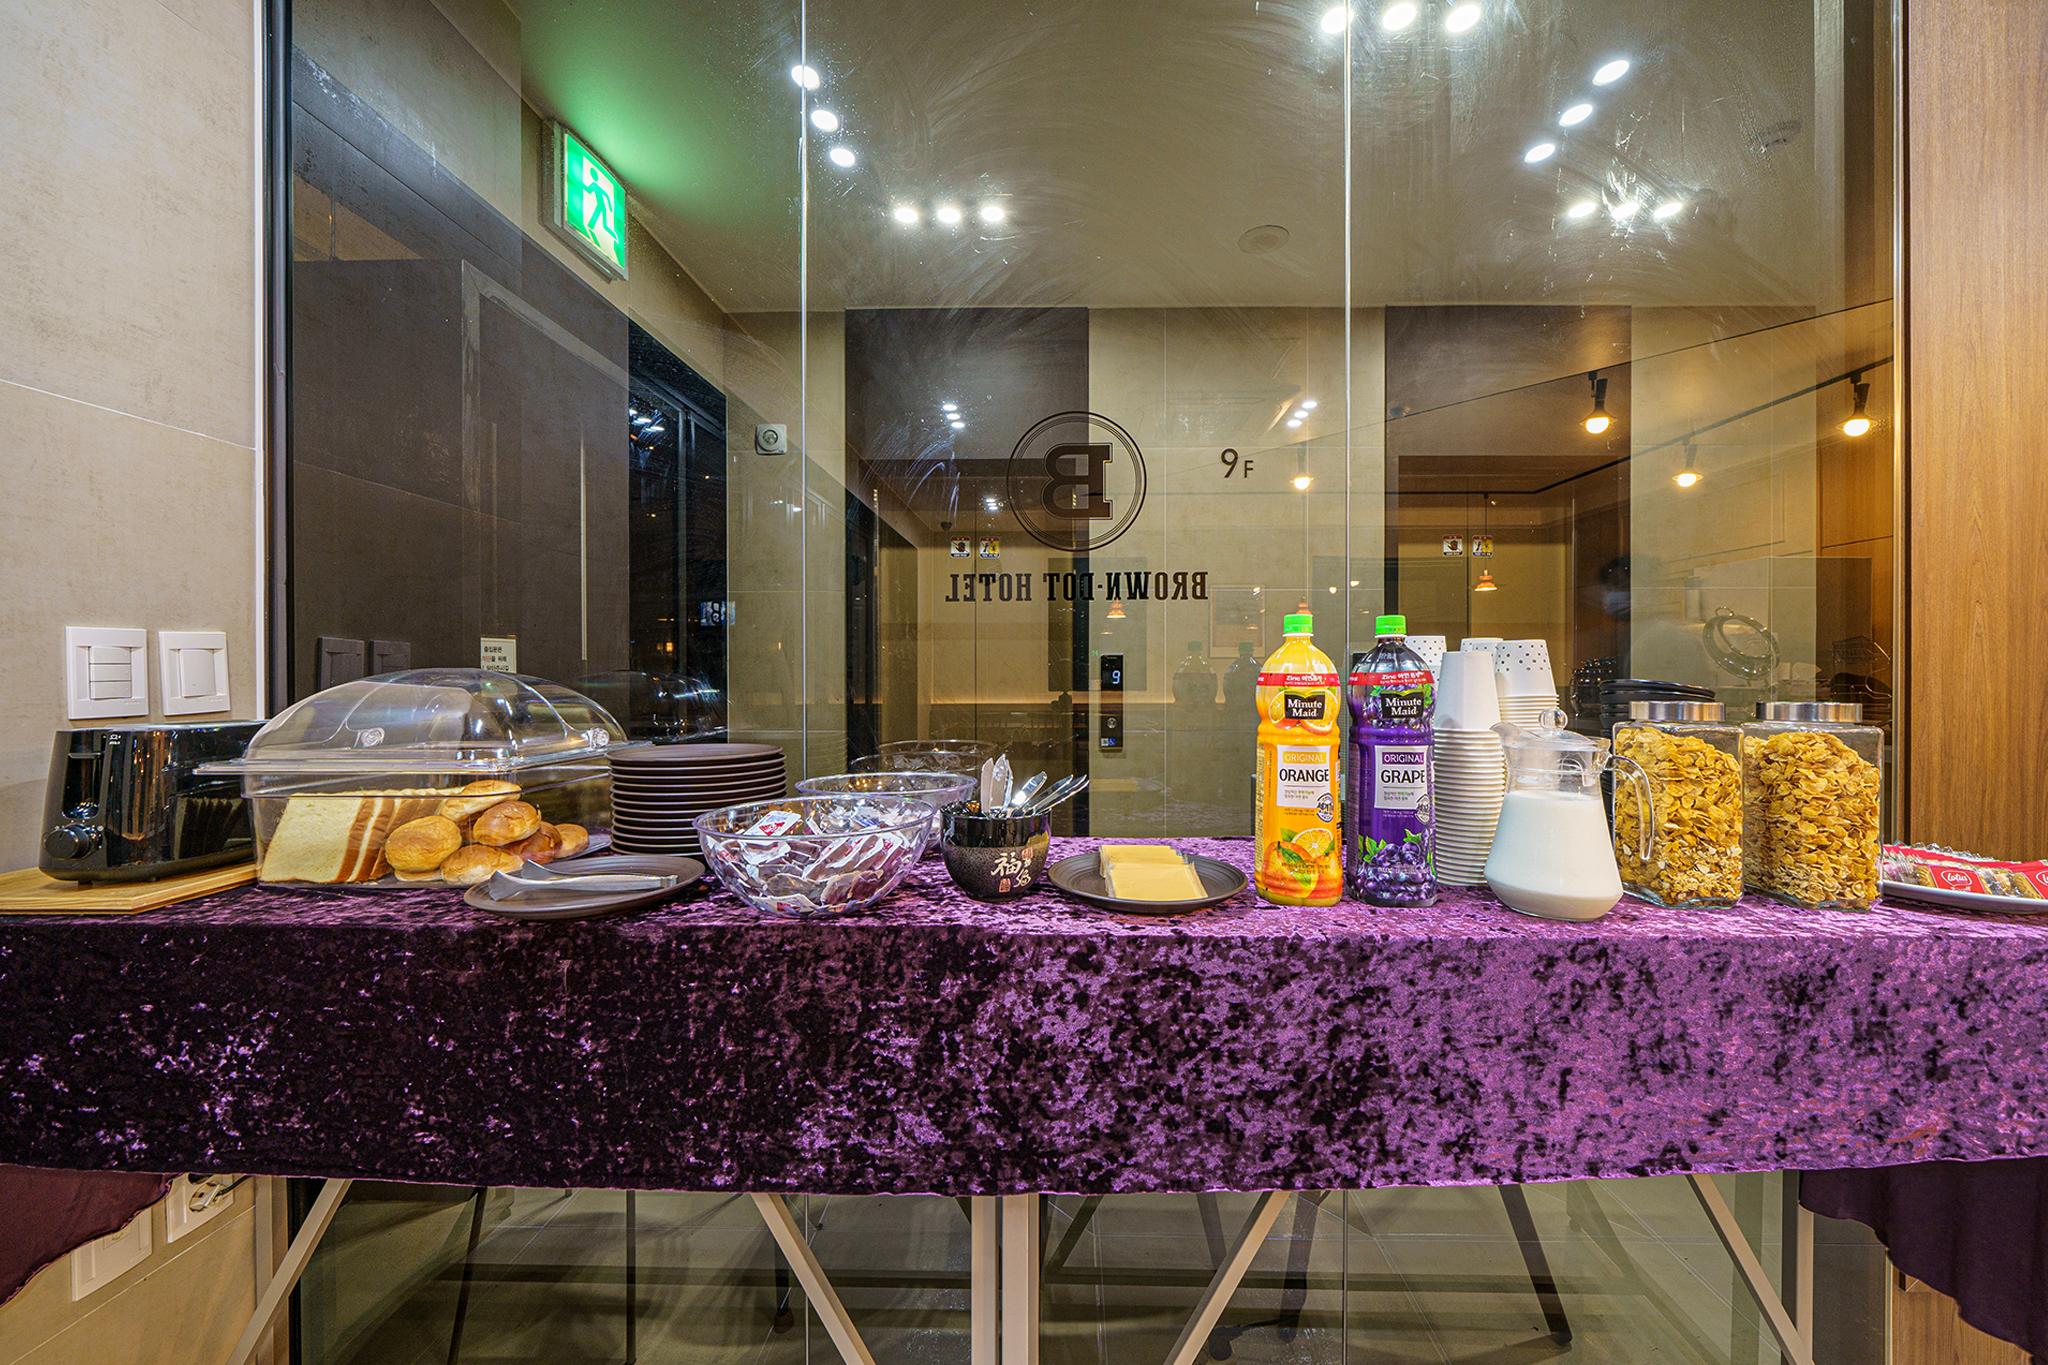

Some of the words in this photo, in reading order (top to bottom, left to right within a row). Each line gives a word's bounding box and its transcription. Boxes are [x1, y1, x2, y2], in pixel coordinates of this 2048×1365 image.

[1112, 670, 1121, 684] 9
[1287, 698, 1323, 709] Minute
[1385, 697, 1422, 708] Minute
[1292, 708, 1317, 717] Maid
[1391, 706, 1418, 716] Maid
[1286, 752, 1325, 763] ORIGINAL
[1383, 753, 1424, 763] ORIGINAL
[1279, 768, 1329, 783] ORANGE
[1381, 769, 1425, 783] GRAPE
[1947, 872, 1968, 883] Lotus
